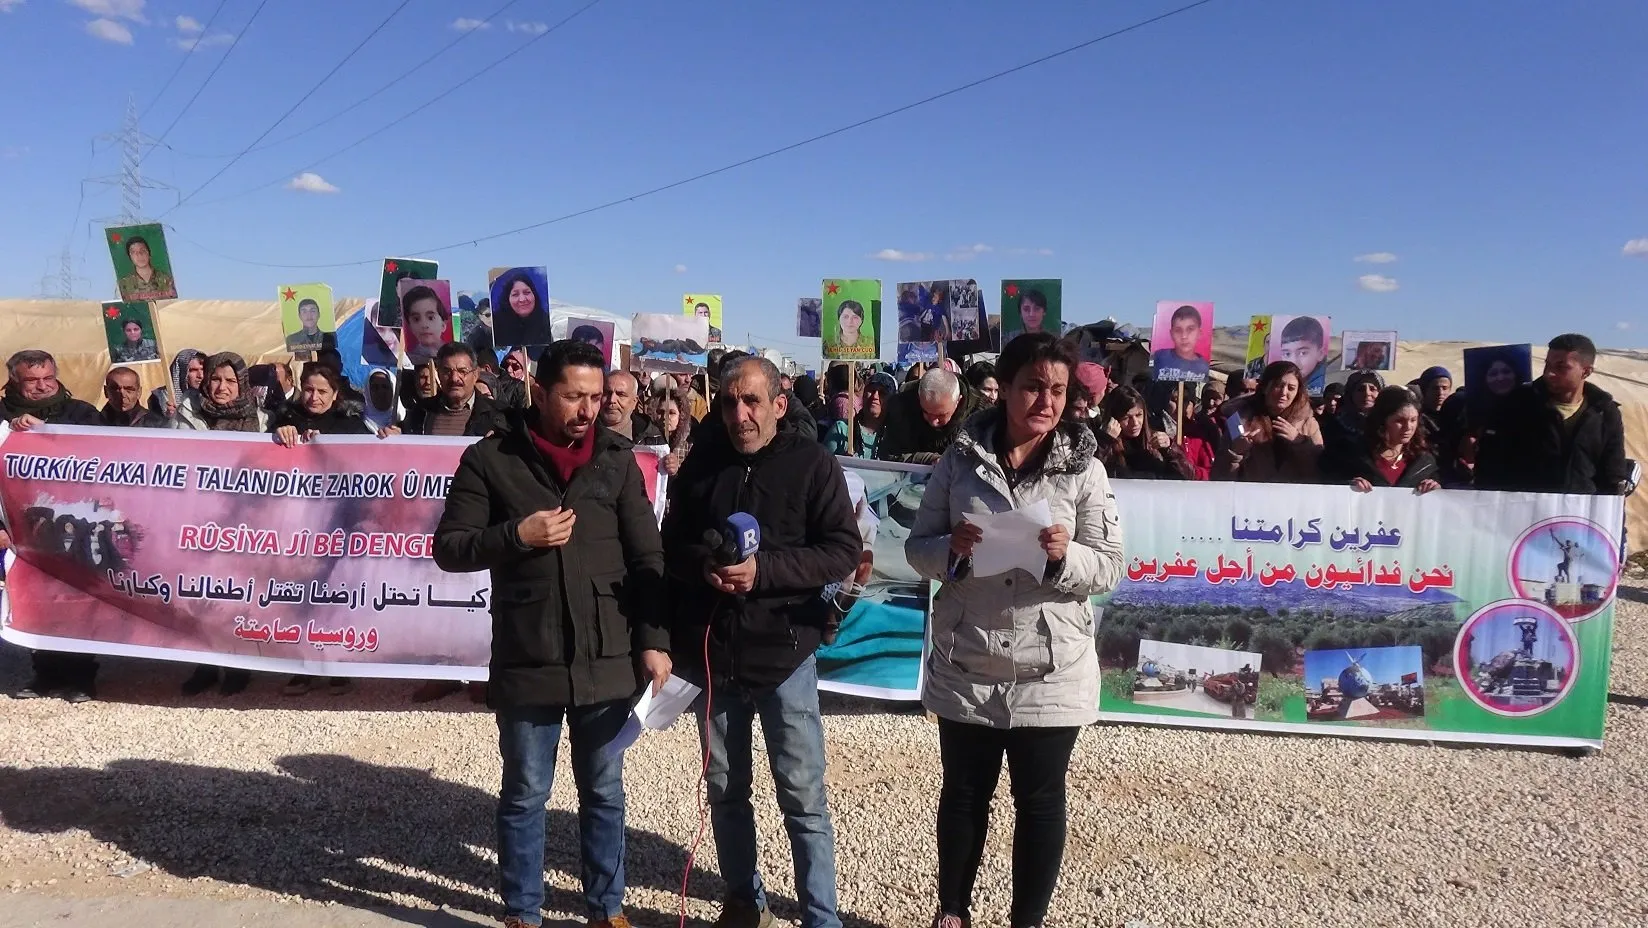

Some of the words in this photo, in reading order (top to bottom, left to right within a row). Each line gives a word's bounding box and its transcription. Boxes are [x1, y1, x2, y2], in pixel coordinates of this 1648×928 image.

[5, 454, 99, 481] TURKİYÊ
[100, 462, 146, 485] AXA
[151, 464, 187, 487] ME
[196, 466, 269, 494] TALAN
[271, 469, 323, 497] DİKE
[325, 473, 394, 497] ZAROK
[403, 470, 419, 498] Û
[180, 523, 279, 553] RÛSİYA
[285, 529, 311, 556] JÎ
[313, 529, 345, 556] BÊ
[743, 529, 758, 549] R
[1231, 515, 1321, 549] كرامتنا
[1329, 520, 1402, 551] عفرين
[1126, 551, 1198, 582] عفرين
[1205, 546, 1253, 585] أجل
[1258, 561, 1297, 587] من
[1305, 556, 1402, 589] فدائيون
[1408, 564, 1454, 593] نحن
[107, 569, 170, 603] وكبارنا
[178, 574, 254, 603] أطفالنا
[259, 579, 303, 607] تقتل
[310, 580, 366, 609] أرضنا
[373, 582, 420, 611] تحتل
[427, 584, 490, 612] كيا
[234, 616, 301, 643] صامتة
[307, 620, 379, 651] وروسيا
